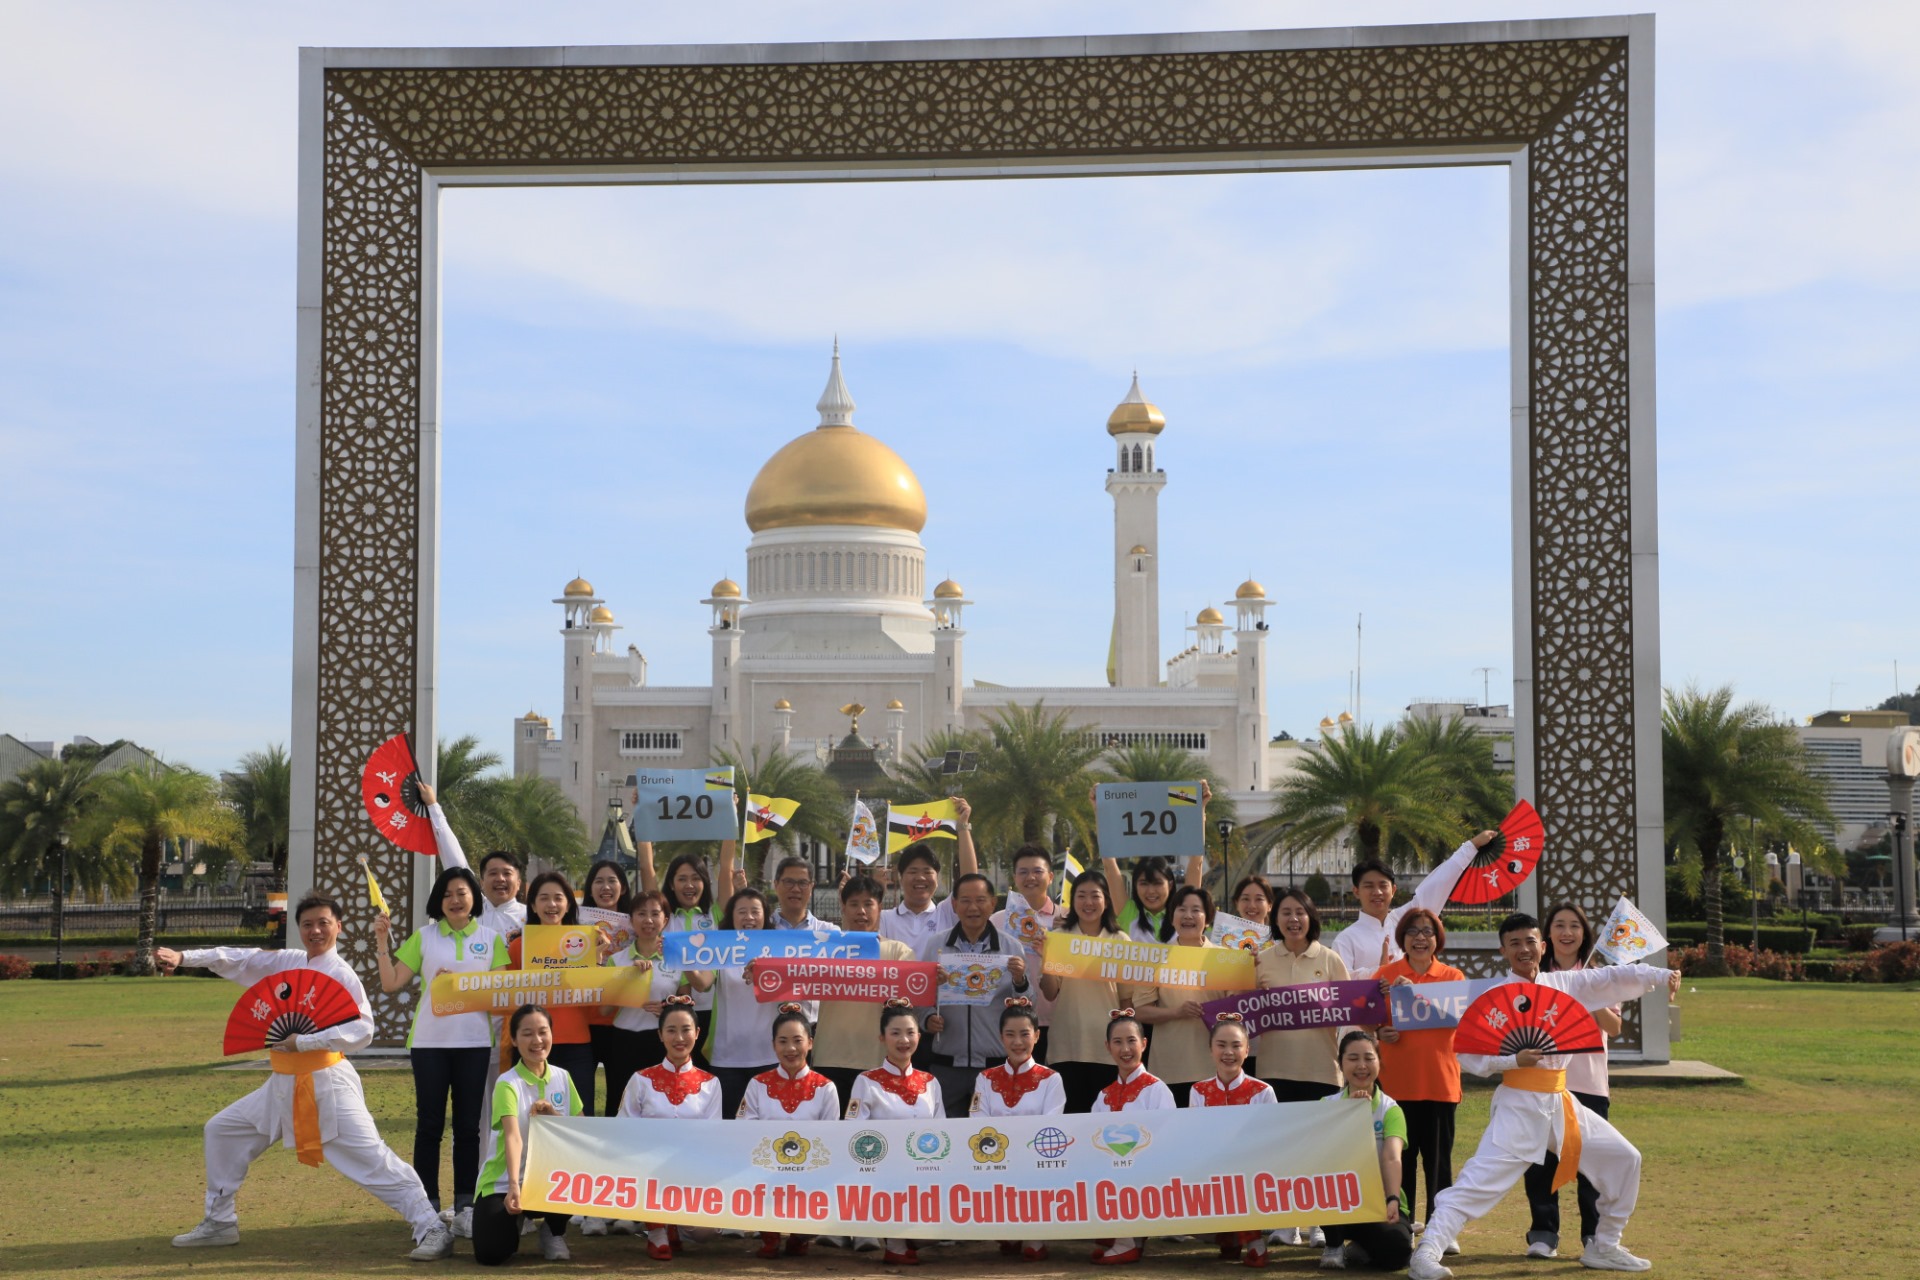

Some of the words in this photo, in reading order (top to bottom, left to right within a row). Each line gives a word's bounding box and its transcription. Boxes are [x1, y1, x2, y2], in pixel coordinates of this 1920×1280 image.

[641, 776, 674, 785] Brunei
[1104, 790, 1137, 800] Brunei
[657, 795, 713, 820] 120
[1122, 810, 1177, 836] 120
[544, 956, 558, 964] Era
[681, 945, 747, 965] LOVE
[758, 945, 773, 958] &
[784, 945, 861, 959] PEACE
[1070, 938, 1169, 964] CONSCIENCE
[458, 971, 562, 991] CONSCIENCE
[787, 963, 877, 979] HAPPINESS
[883, 966, 899, 979] IS
[1101, 962, 1118, 978] IN
[1122, 964, 1155, 982] OUR
[1159, 967, 1208, 987] HEART
[492, 991, 510, 1007] IN
[515, 990, 548, 1007] OUR
[553, 988, 604, 1005] HEART
[792, 983, 899, 998] EVERYWHERE
[1237, 986, 1340, 1014] CONSCIENCE
[1396, 996, 1468, 1022] LOVE
[1241, 1019, 1257, 1036] N
[1260, 1012, 1295, 1028] OUR
[1300, 1007, 1351, 1024] HEART
[1037, 1160, 1068, 1168] HTTF
[547, 1170, 637, 1208] 2025
[646, 1178, 723, 1215] Love
[732, 1183, 766, 1217] of
[773, 1184, 829, 1220] the
[836, 1185, 941, 1223] World
[949, 1181, 1088, 1224] Cultural
[1095, 1174, 1248, 1221] Goodwill
[1253, 1171, 1361, 1213] Group
